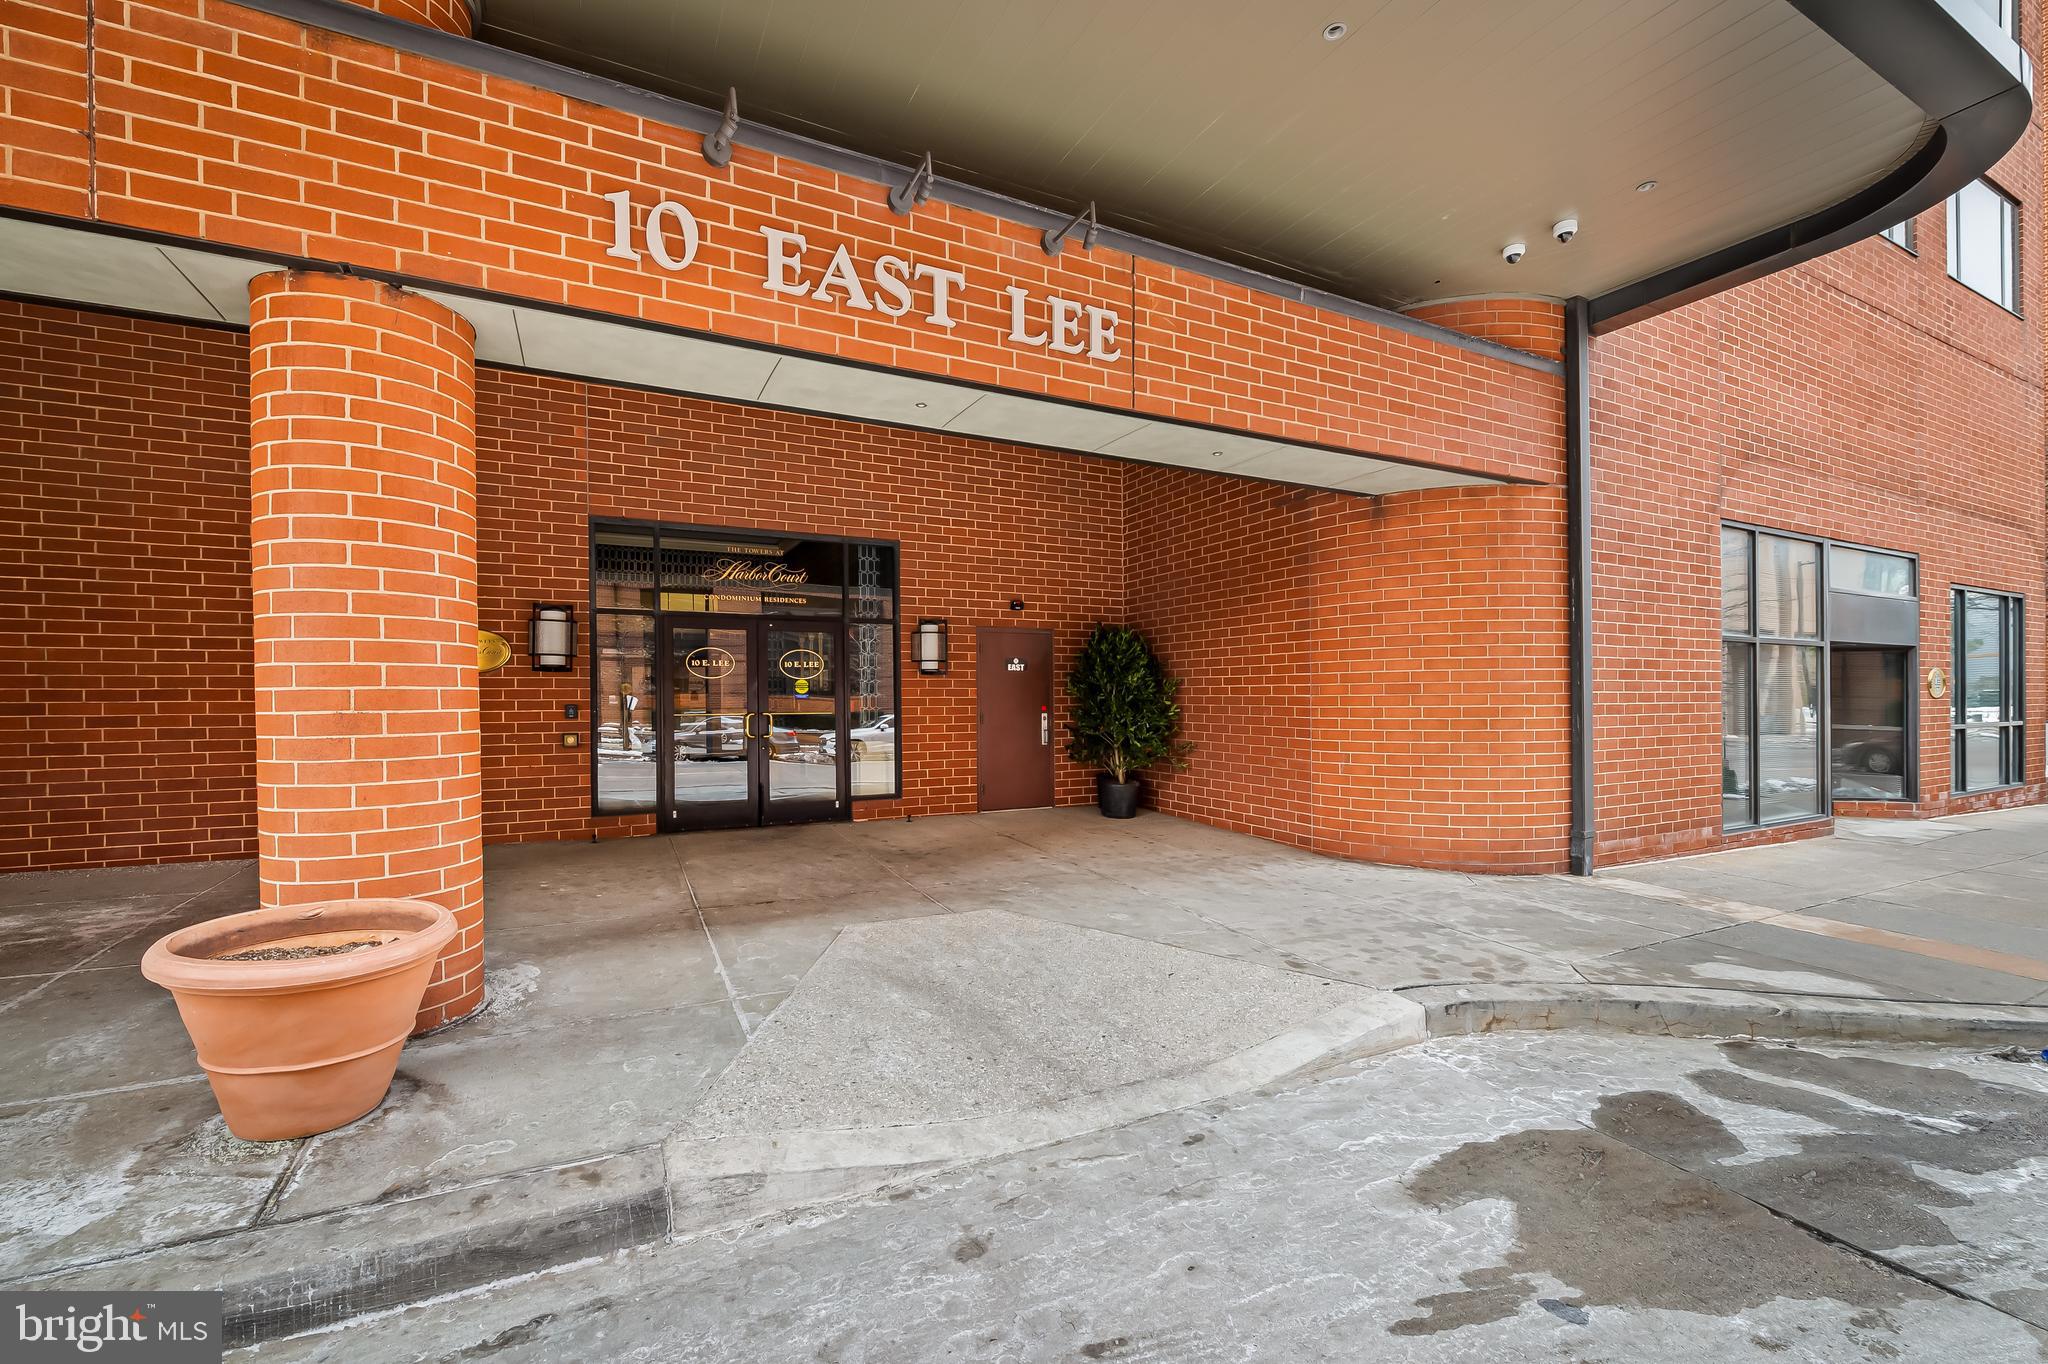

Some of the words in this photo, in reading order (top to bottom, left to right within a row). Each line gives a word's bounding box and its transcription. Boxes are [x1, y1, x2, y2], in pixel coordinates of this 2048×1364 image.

[604, 190, 699, 271] 10
[759, 225, 966, 329] EAST
[1004, 285, 1122, 363] LEE
[744, 547, 773, 555] TOWERS
[703, 594, 761, 602] CONDOMINIUM
[764, 596, 807, 604] RESIDENCES
[691, 659, 700, 667] 10
[702, 659, 711, 667] E.
[712, 659, 730, 667] LEE
[1007, 663, 1025, 671] EAST
